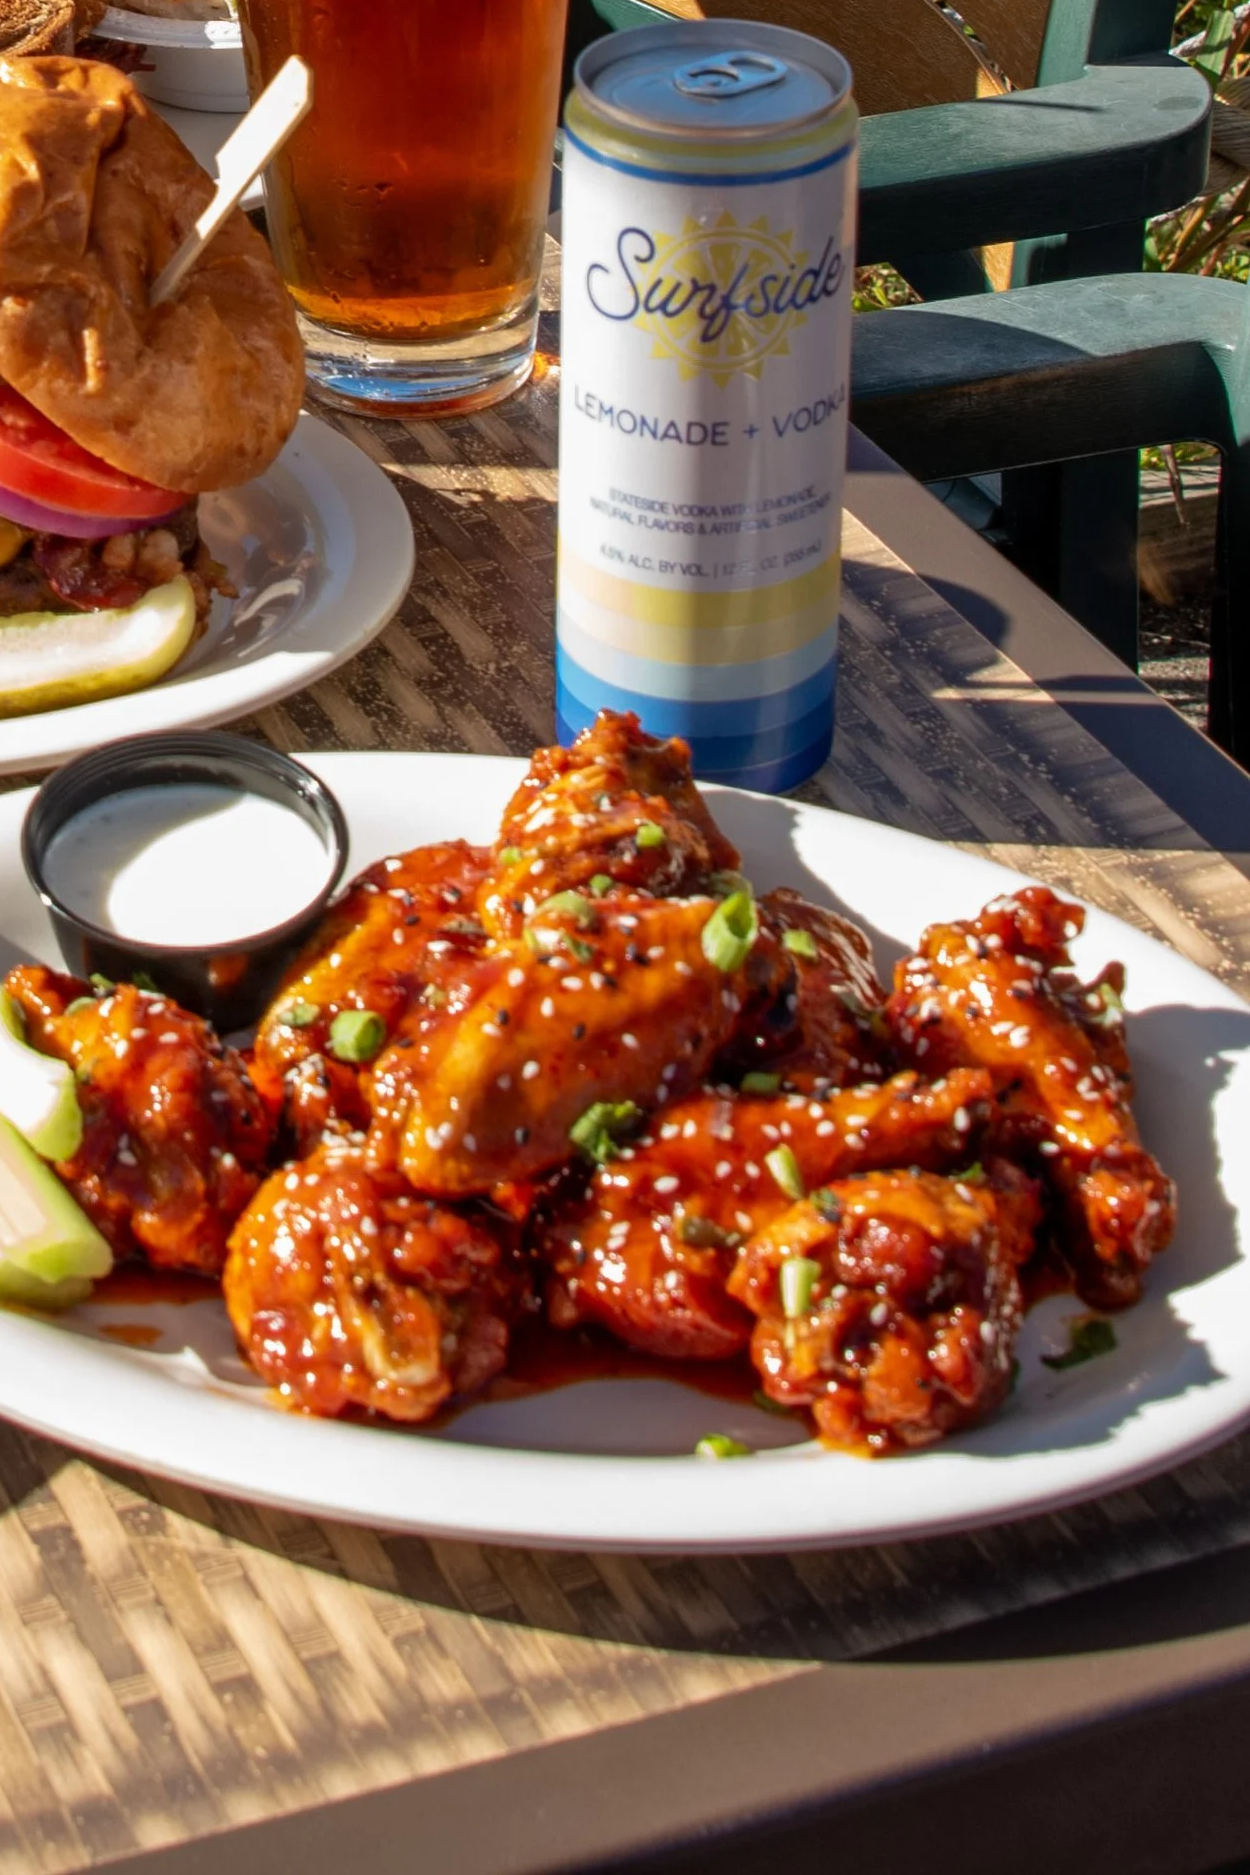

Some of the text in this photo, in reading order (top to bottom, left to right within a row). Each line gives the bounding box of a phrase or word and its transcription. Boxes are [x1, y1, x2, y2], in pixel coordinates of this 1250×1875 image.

[587, 227, 842, 342] Surfside
[575, 384, 730, 446] LEMONADE
[672, 502, 718, 518] VODKA
[721, 504, 752, 517] WIT
[658, 560, 676, 574] BY
